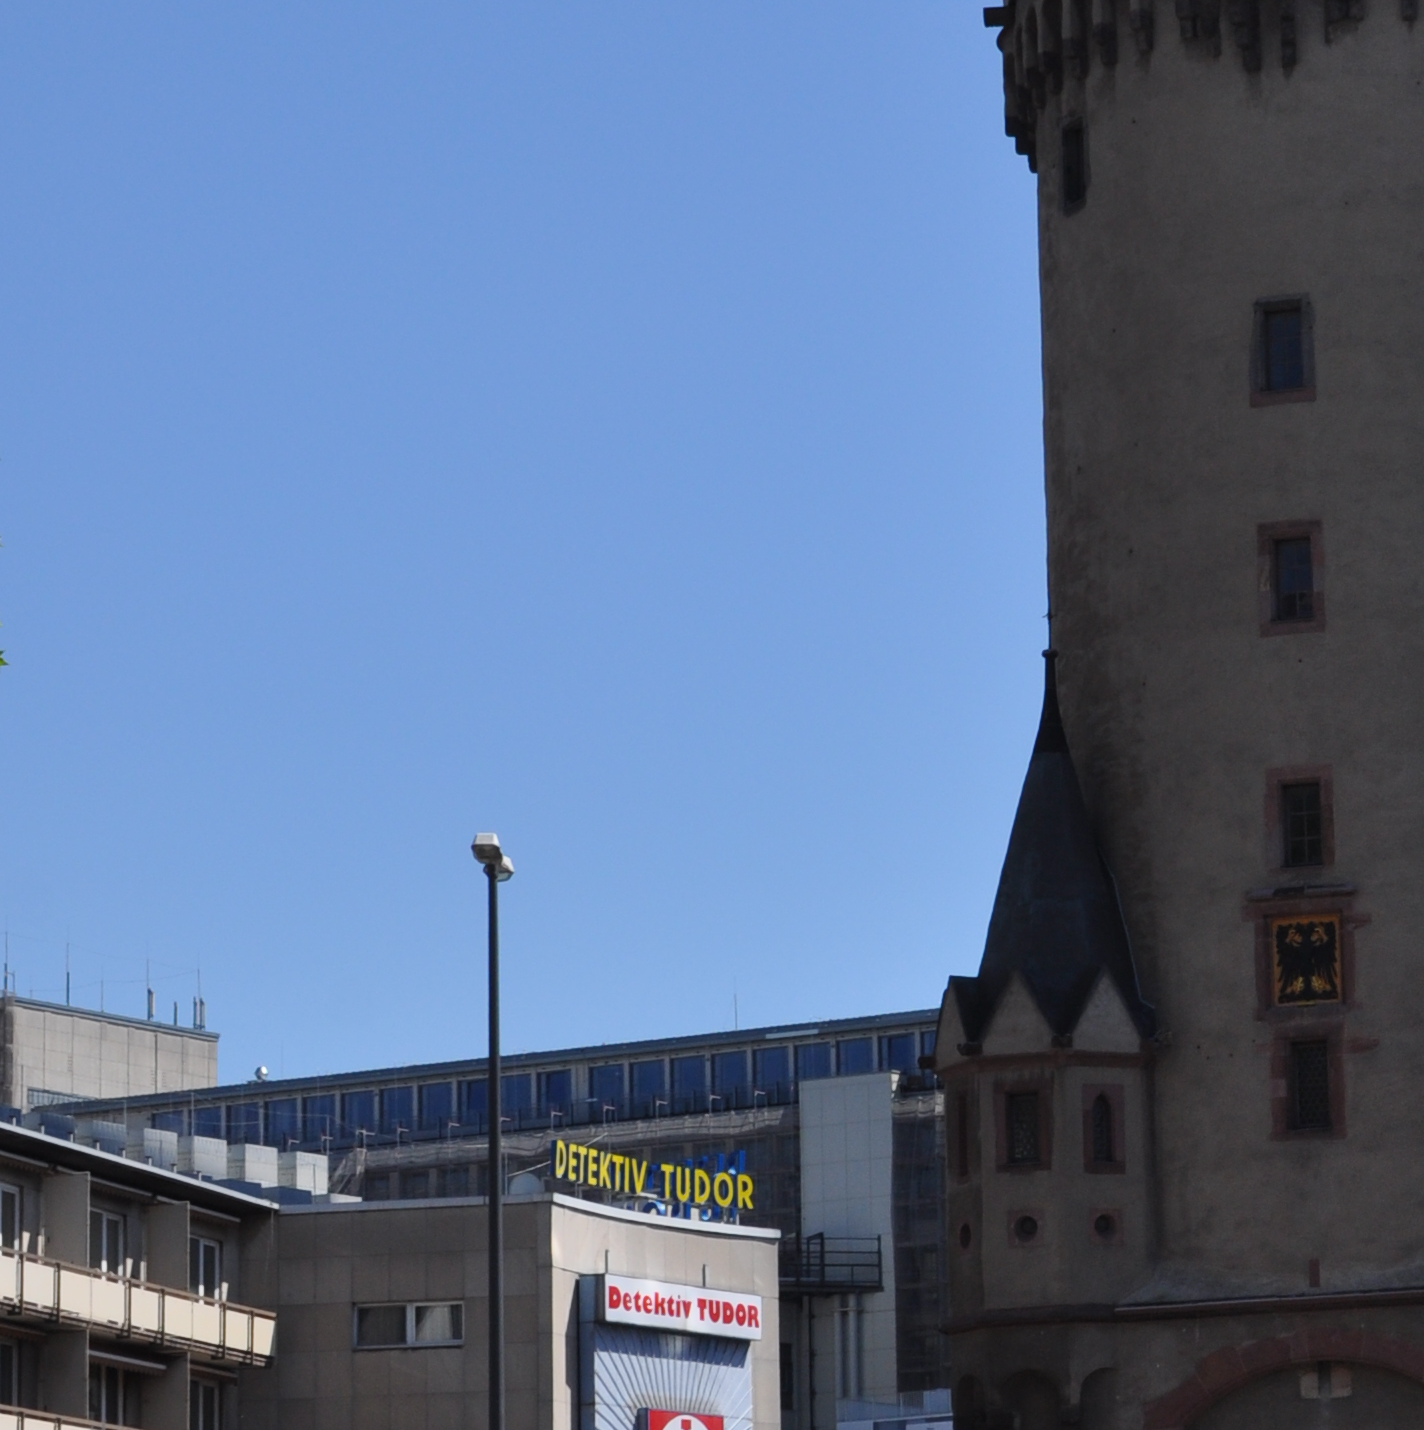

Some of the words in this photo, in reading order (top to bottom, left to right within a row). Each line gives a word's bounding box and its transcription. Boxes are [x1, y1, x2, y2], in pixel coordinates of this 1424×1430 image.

[555, 1140, 647, 1194] DETEKTIV
[661, 1164, 754, 1209] TUDOR
[608, 1285, 692, 1319] Detektiv
[697, 1298, 760, 1328] TUDOR
